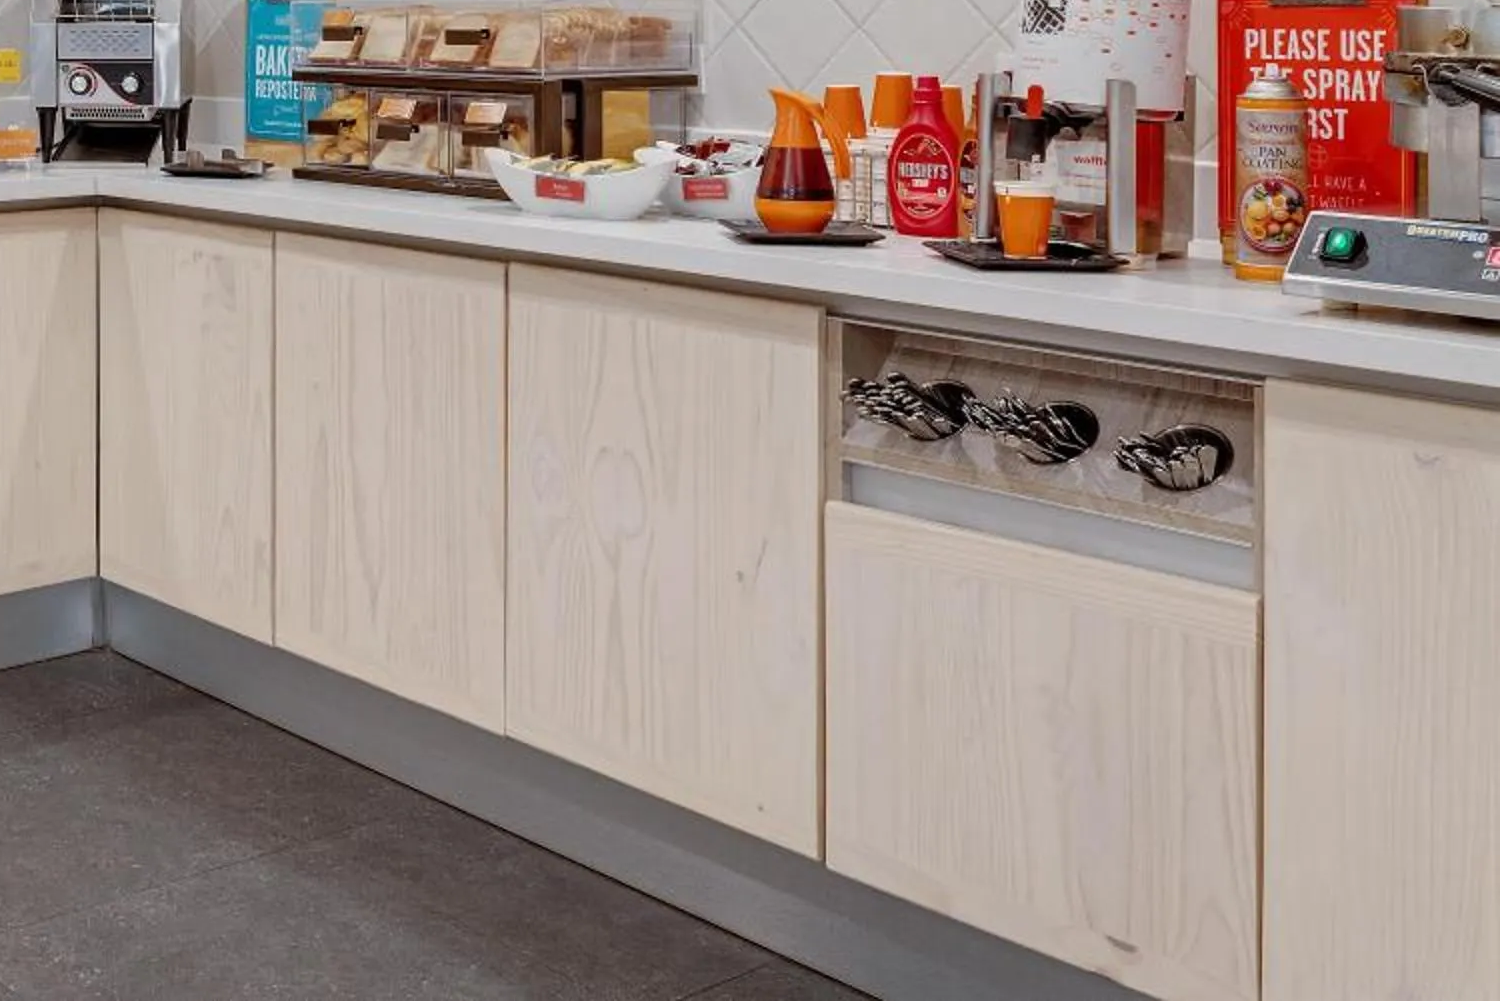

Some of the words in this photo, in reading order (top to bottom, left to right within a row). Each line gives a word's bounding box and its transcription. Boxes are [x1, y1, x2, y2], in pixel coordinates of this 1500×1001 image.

[1244, 28, 1331, 61] PLEASE
[1340, 29, 1387, 62] USE
[1303, 68, 1381, 102] SPRAY
[1307, 107, 1349, 140] RST
[1259, 146, 1287, 158] PAN
